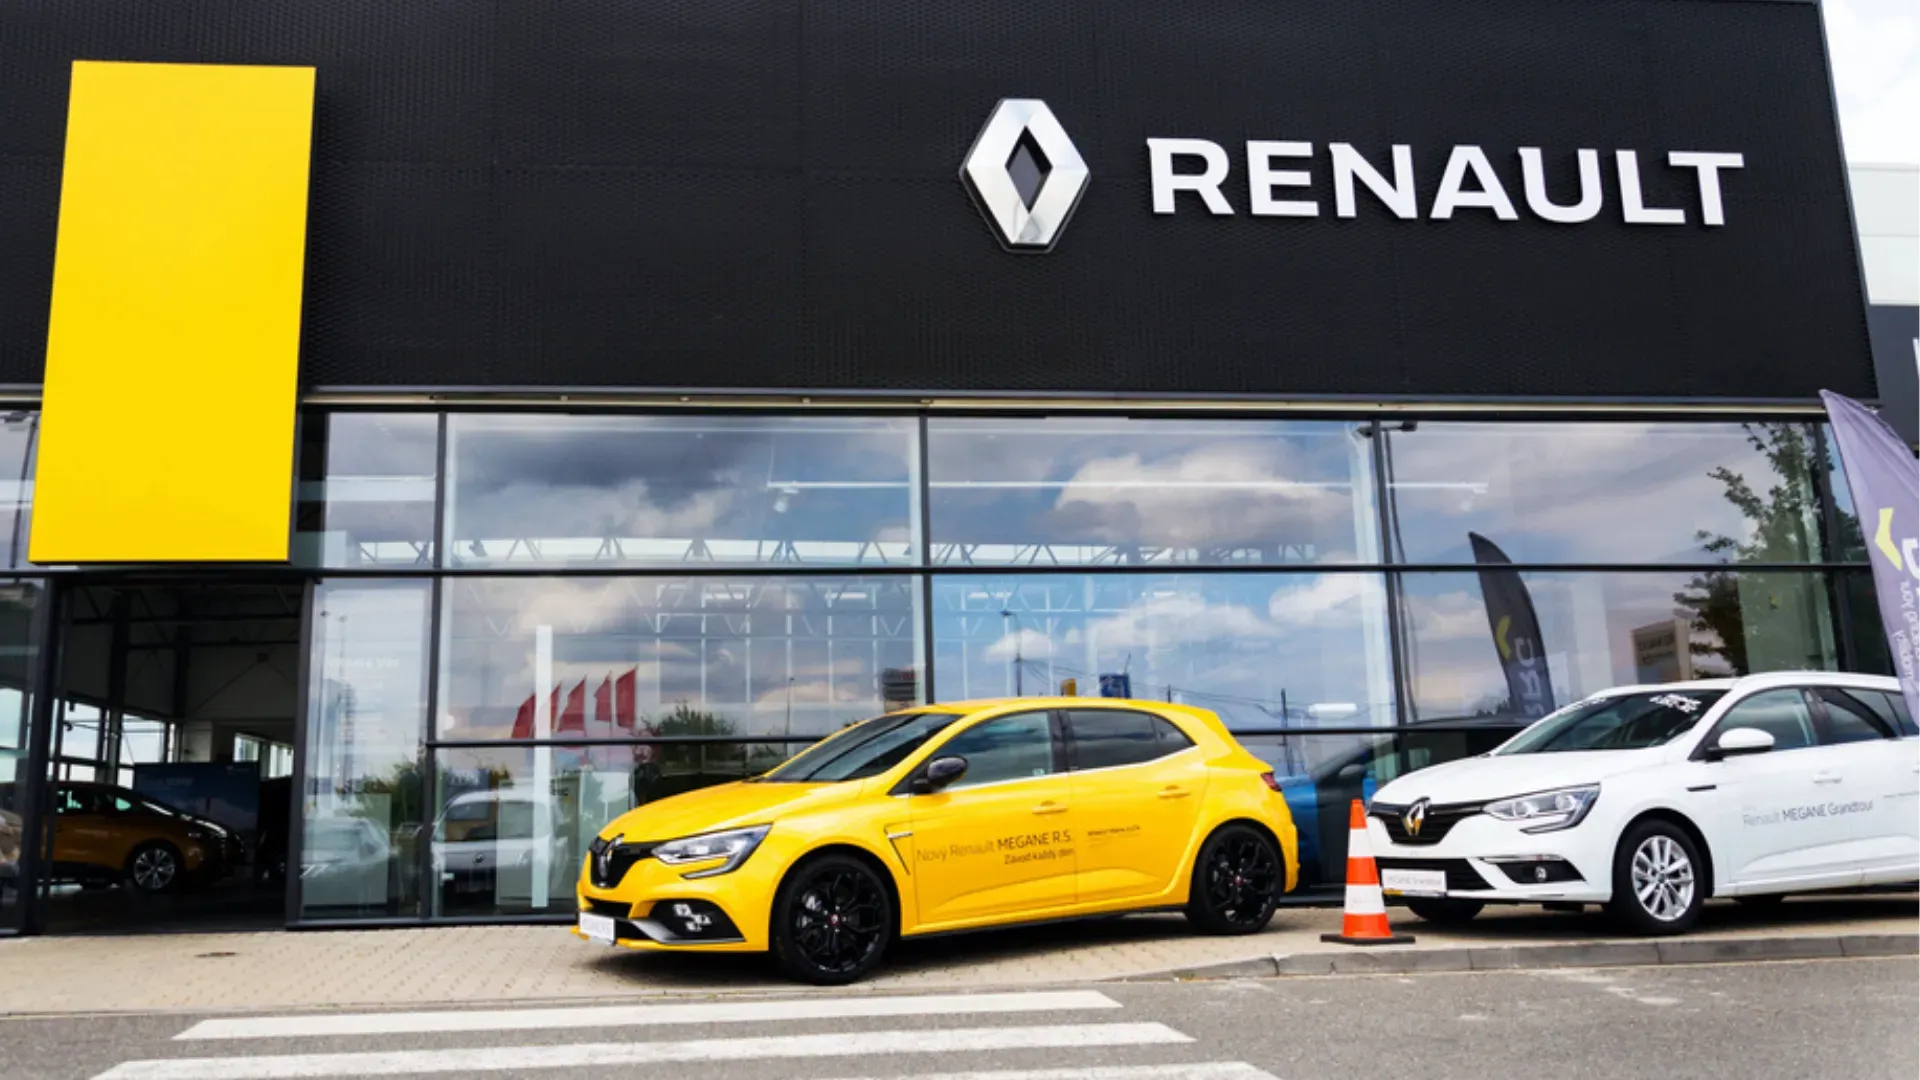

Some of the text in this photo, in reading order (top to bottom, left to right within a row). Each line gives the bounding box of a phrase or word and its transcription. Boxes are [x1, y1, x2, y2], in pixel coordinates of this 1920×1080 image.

[1147, 137, 1744, 225] RENAULT
[1782, 803, 1826, 822] MEGANE
[950, 839, 994, 857] Renault
[996, 832, 1049, 851] MEGANE
